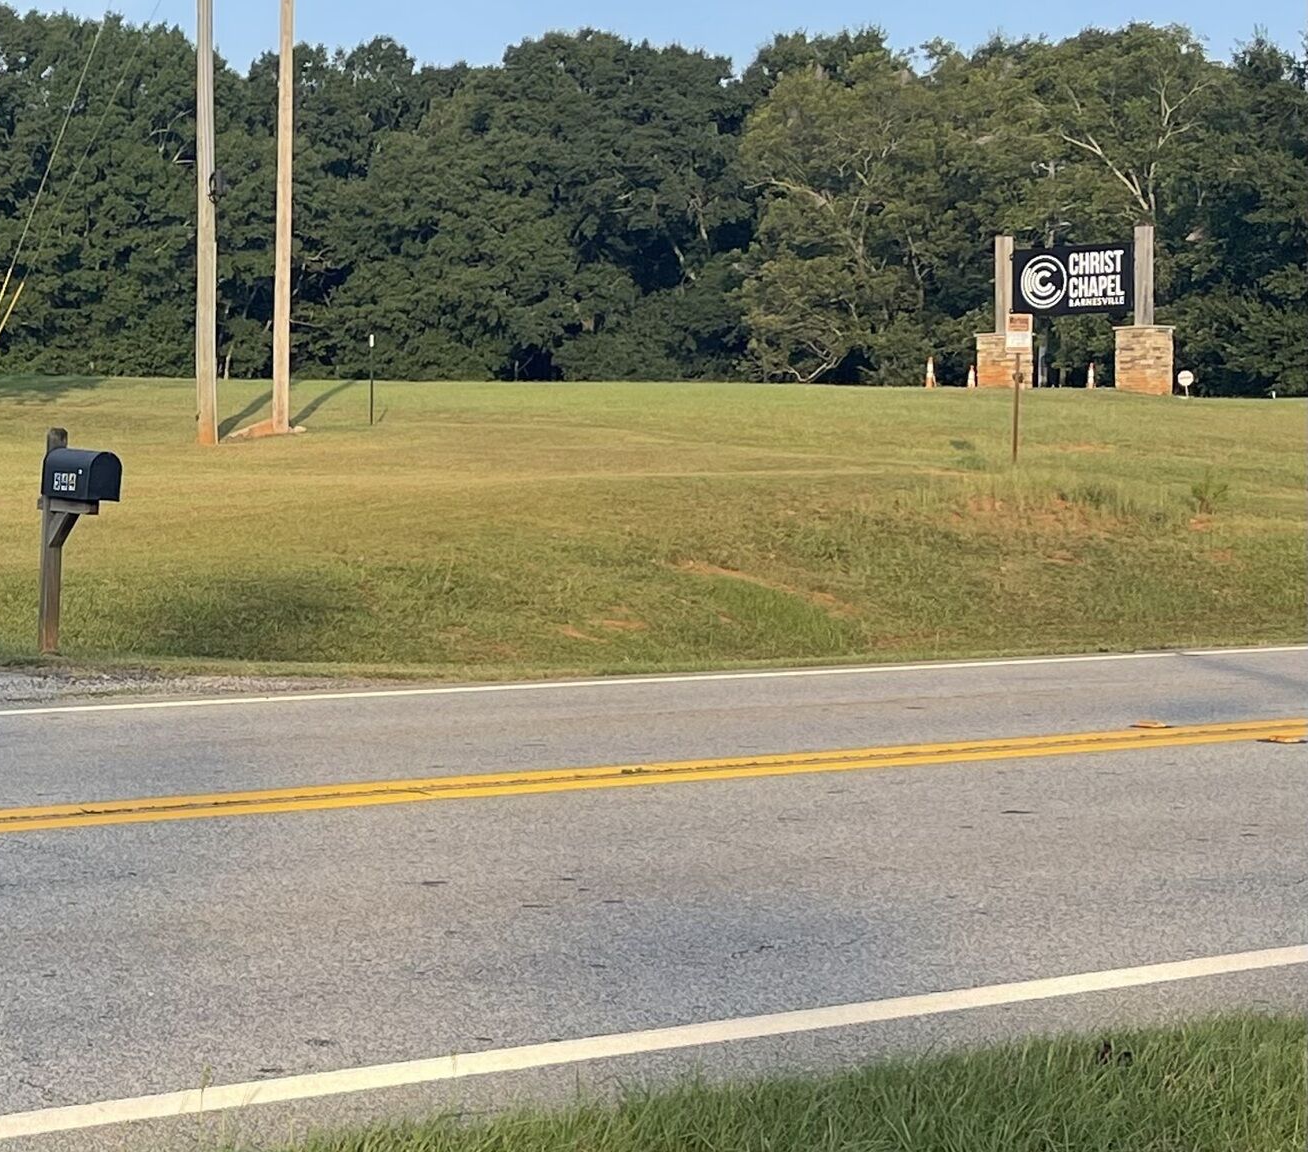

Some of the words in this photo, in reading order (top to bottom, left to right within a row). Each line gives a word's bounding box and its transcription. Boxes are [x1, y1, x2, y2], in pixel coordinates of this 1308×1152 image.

[1068, 250, 1124, 275] CHRIST
[1068, 275, 1125, 298] CHAPEL
[1068, 296, 1124, 307] BARNESVILLE
